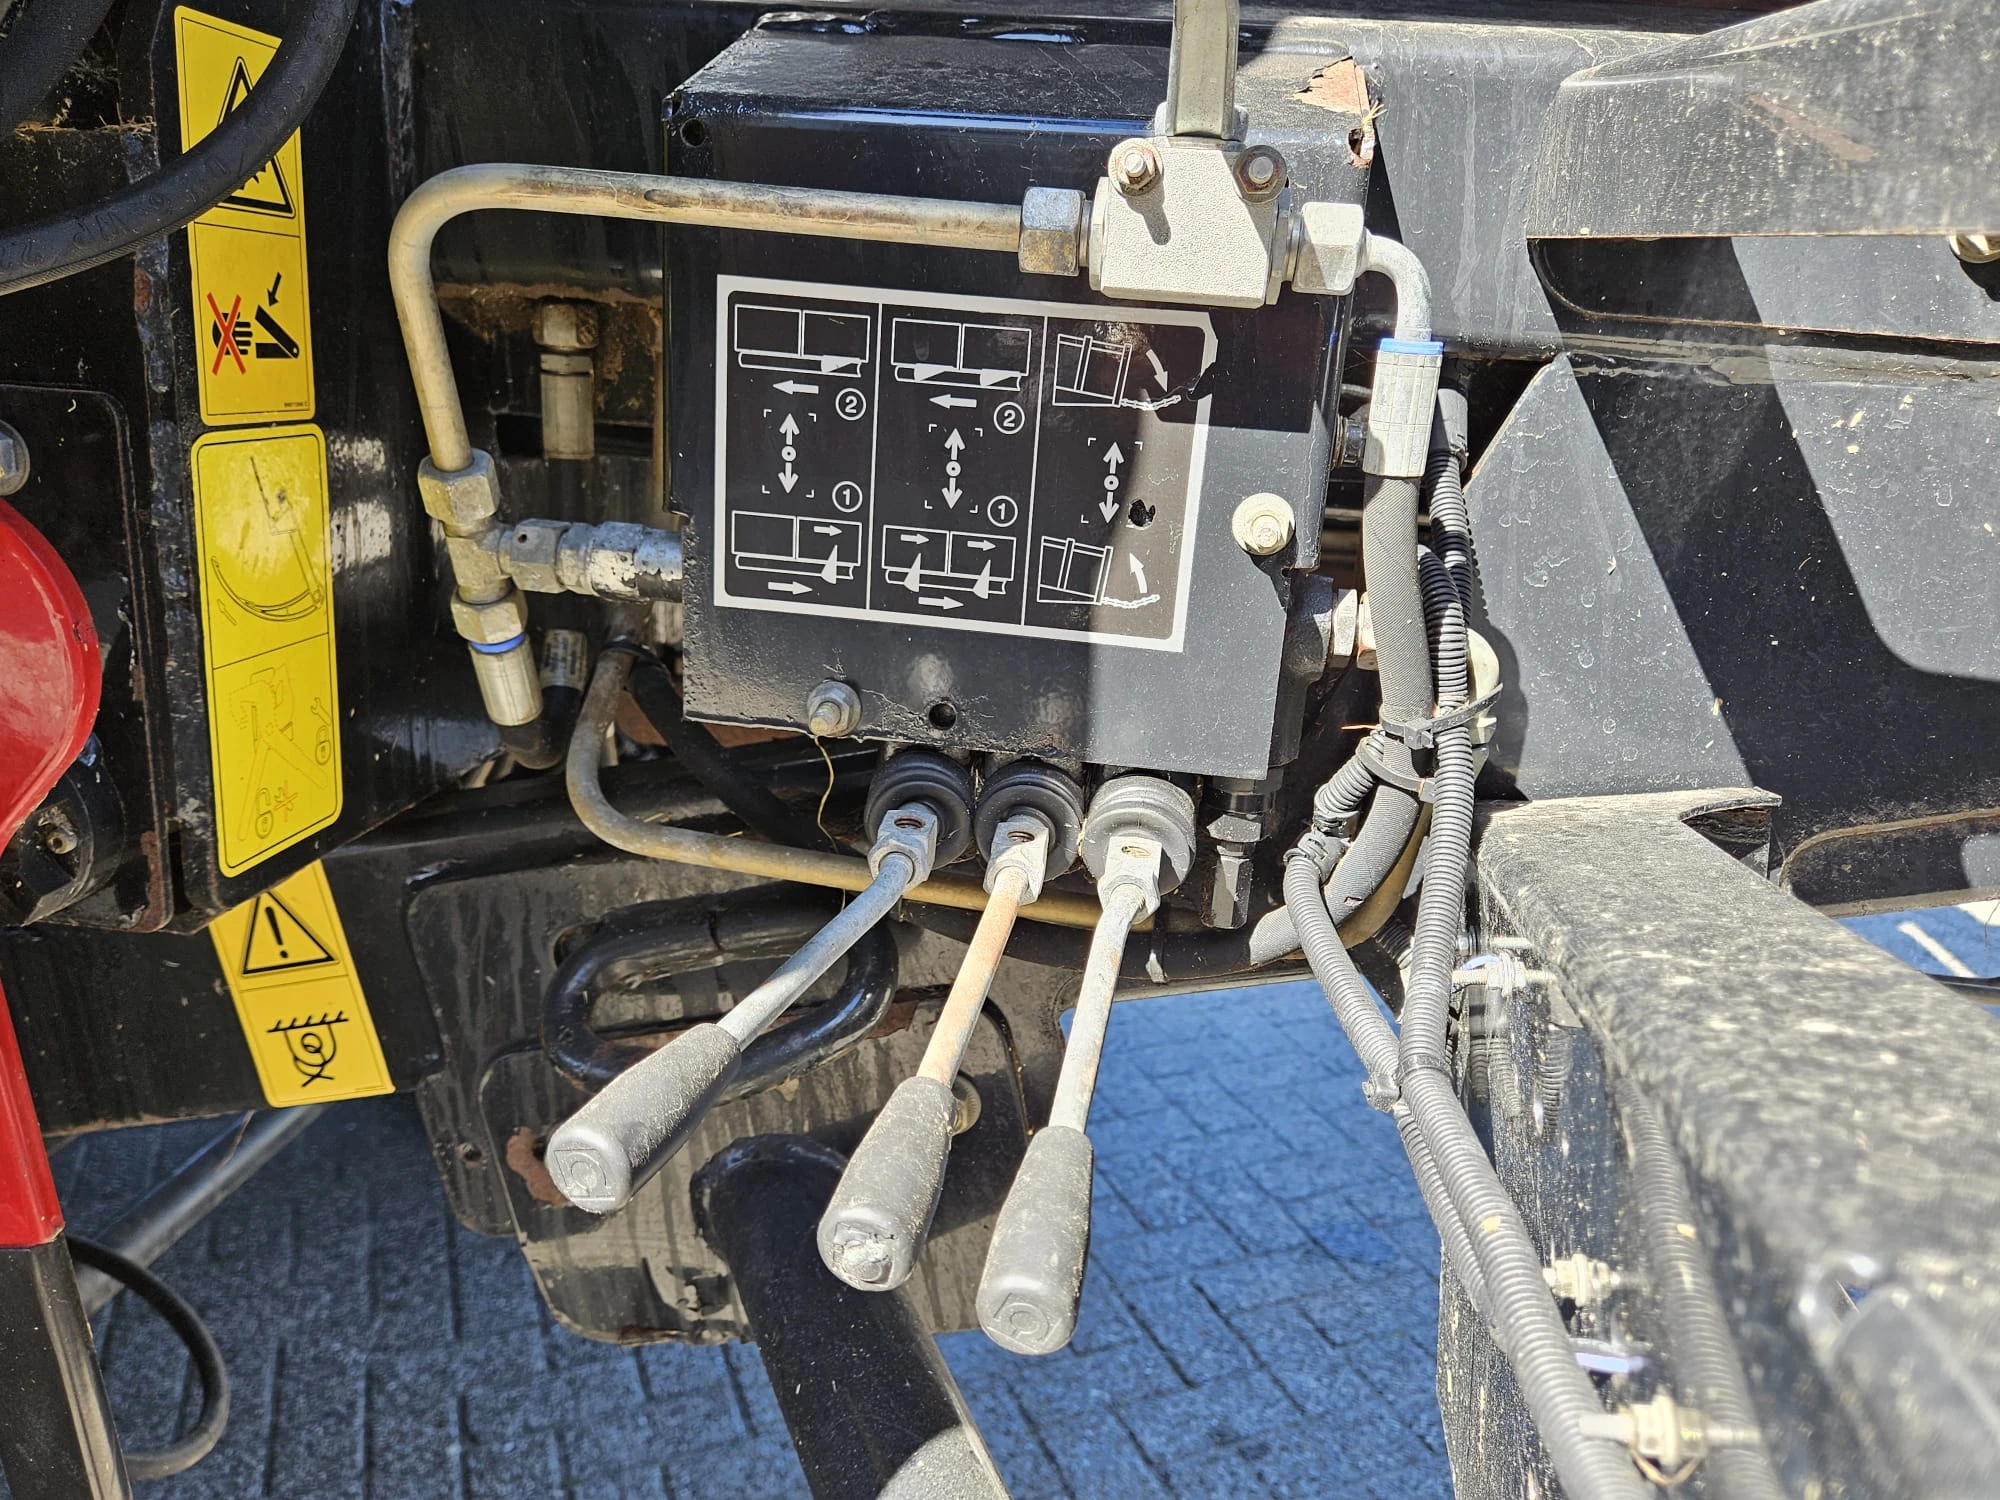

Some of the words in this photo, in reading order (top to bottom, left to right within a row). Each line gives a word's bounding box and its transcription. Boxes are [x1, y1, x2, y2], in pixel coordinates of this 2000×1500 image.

[845, 395, 858, 413] 2
[1003, 409, 1016, 428] 2
[842, 488, 851, 505] 1
[997, 502, 1006, 521] 1
